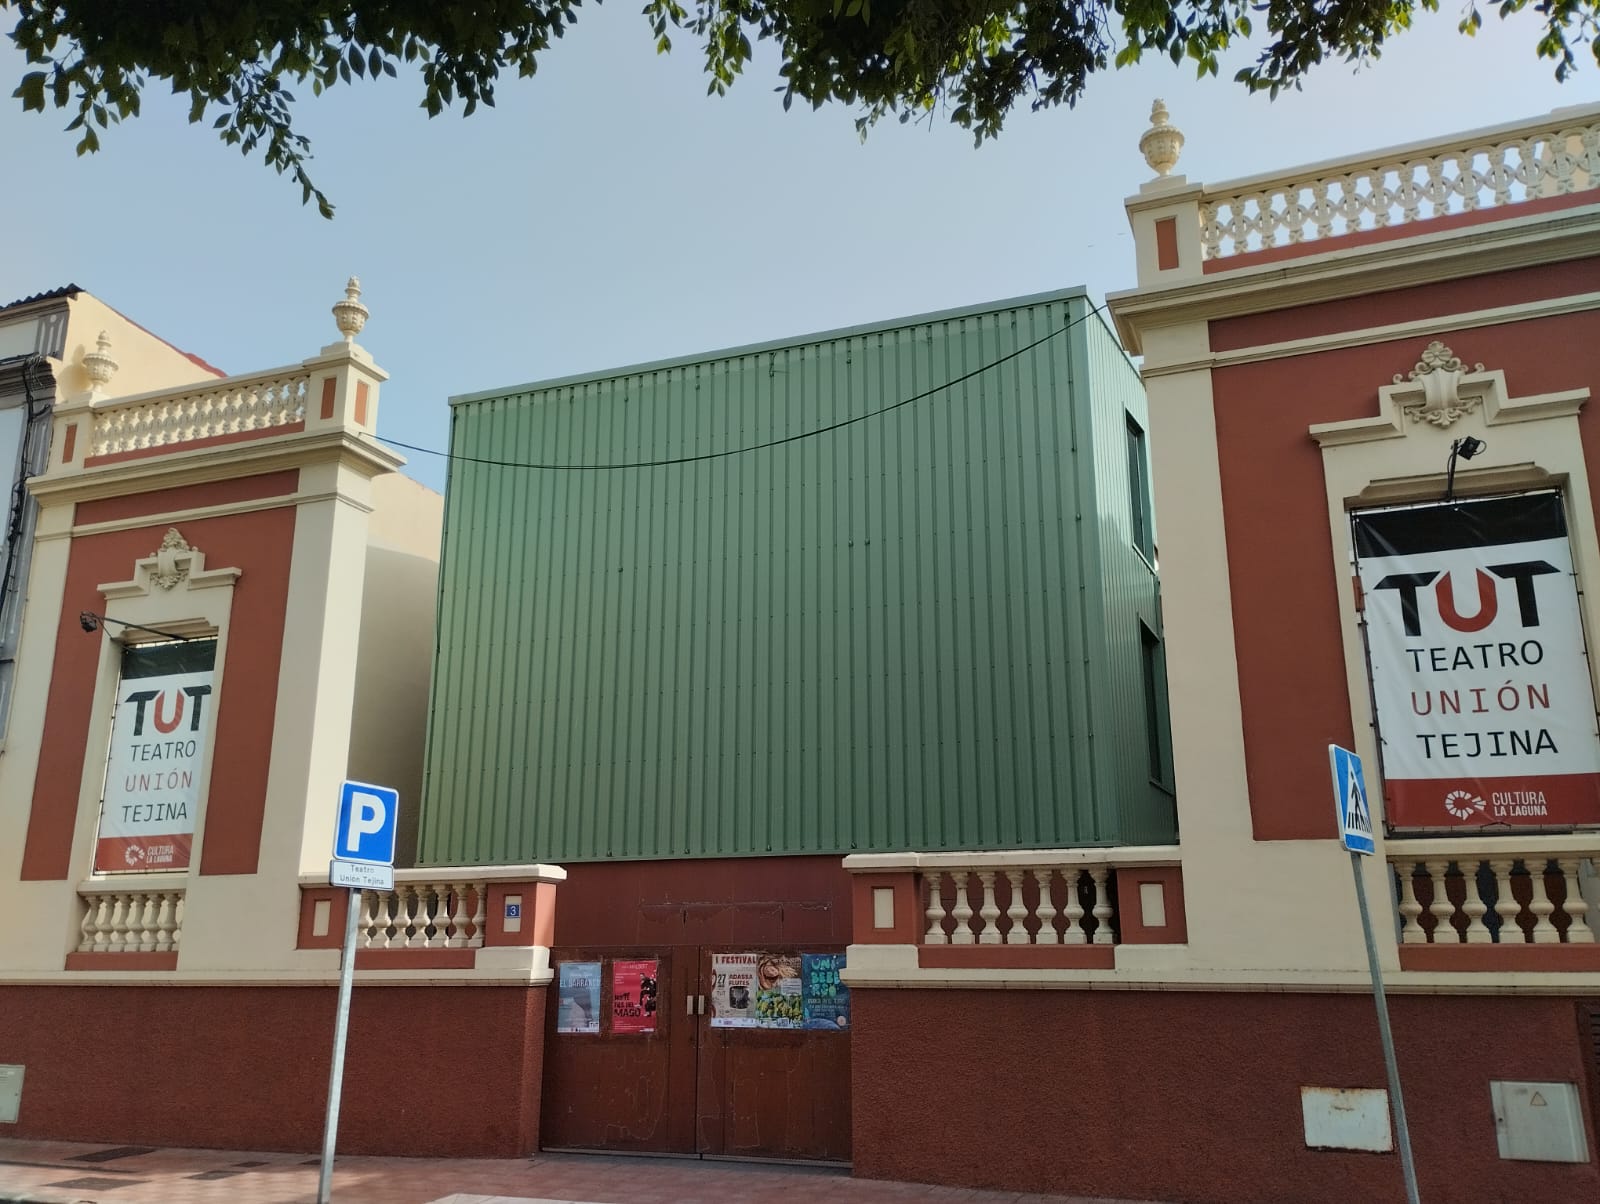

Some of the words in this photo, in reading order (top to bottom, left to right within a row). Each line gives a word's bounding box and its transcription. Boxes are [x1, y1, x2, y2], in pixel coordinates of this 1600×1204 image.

[1373, 560, 1561, 637] TUT
[1406, 639, 1544, 673] TEATRO
[1411, 680, 1551, 716] UNIÓN
[124, 684, 212, 737] TUT
[130, 740, 197, 762] TEATRO
[1416, 728, 1559, 759] TEJINA
[125, 767, 193, 793] UNIÓN
[1492, 791, 1547, 806] CULTURA
[122, 801, 188, 823] TEJINA
[1494, 805, 1507, 817] LA
[1509, 804, 1548, 817] LAGUNA
[346, 791, 386, 853] P
[147, 844, 174, 856] CULTURA
[350, 864, 375, 874] Teatro
[362, 875, 385, 886] Tejina
[510, 905, 517, 916] 3
[721, 955, 757, 965] FESTIVAL
[717, 973, 727, 985] 27
[614, 1009, 641, 1017] MAGO
